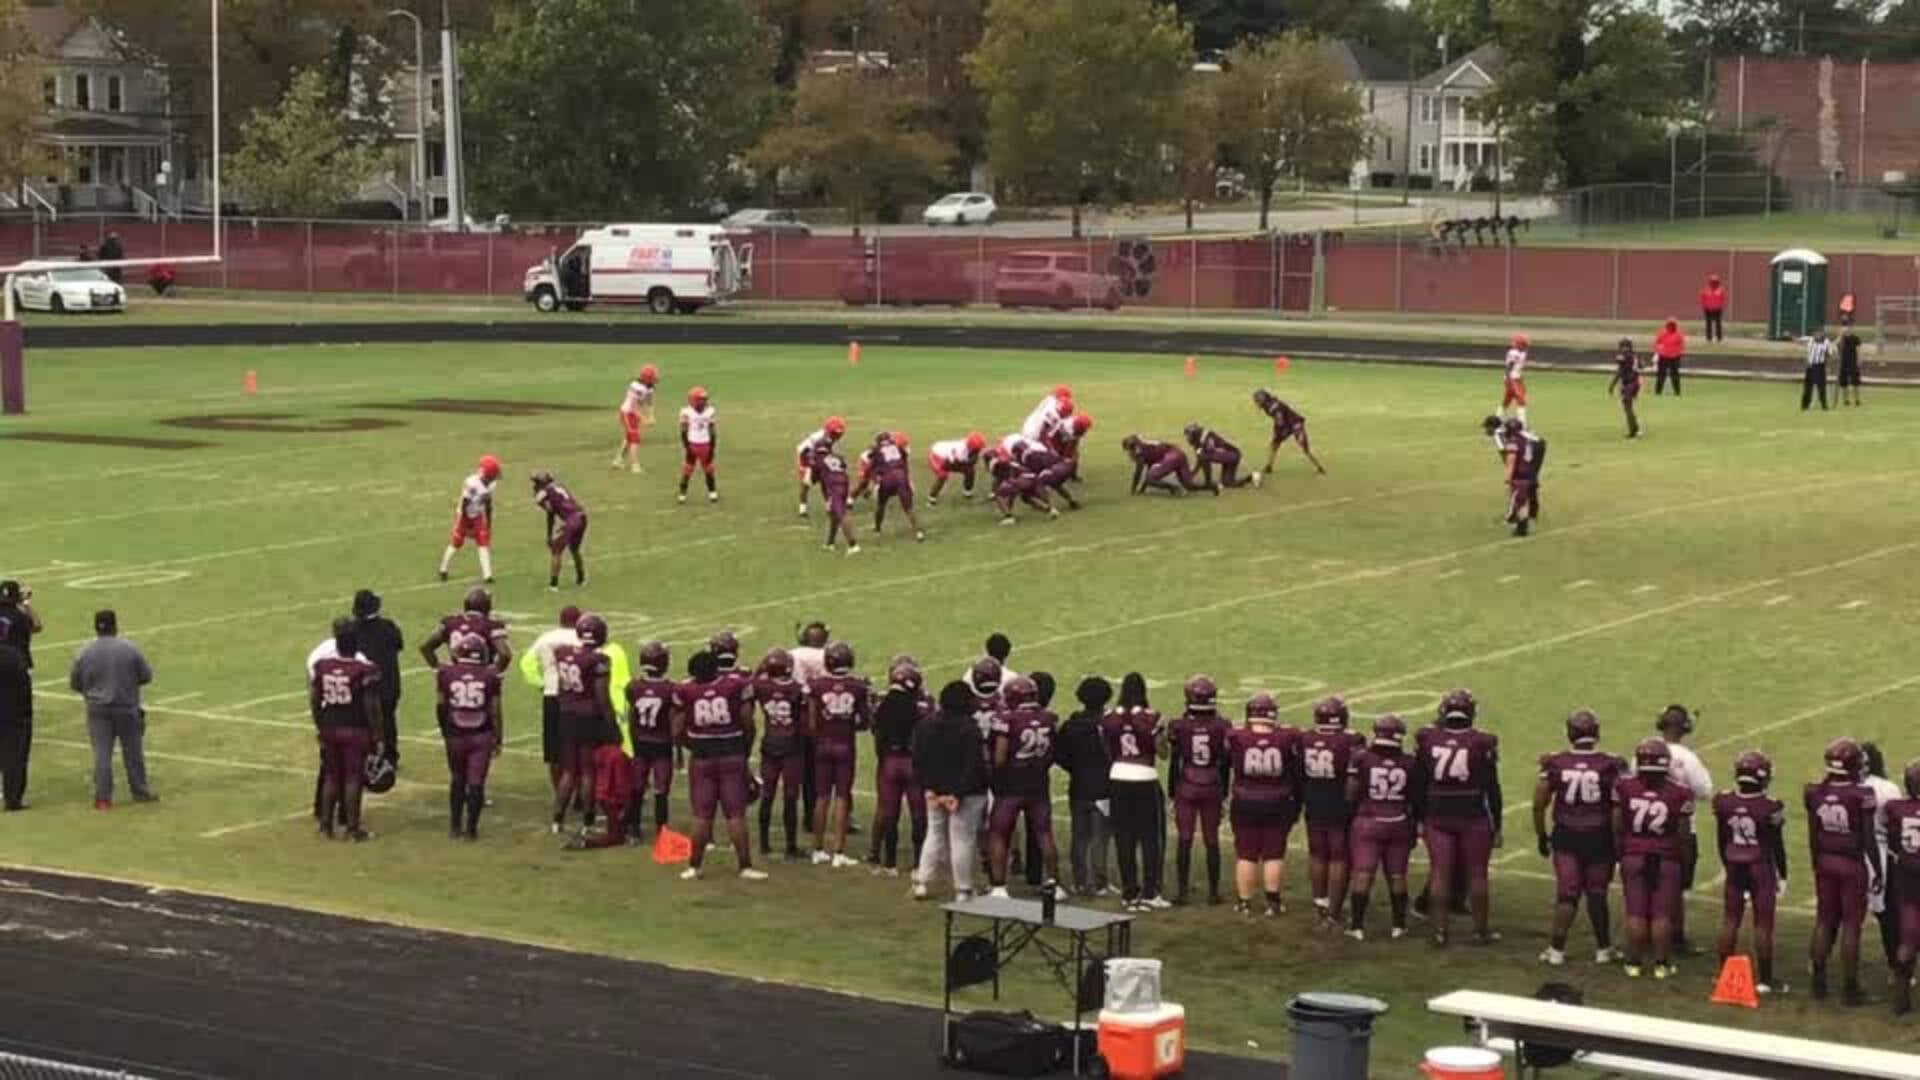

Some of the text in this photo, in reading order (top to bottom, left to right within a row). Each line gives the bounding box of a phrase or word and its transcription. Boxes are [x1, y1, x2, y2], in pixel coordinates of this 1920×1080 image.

[323, 674, 352, 704] 55
[450, 681, 484, 708] 35
[693, 696, 730, 726] 88
[1015, 727, 1050, 759] 25
[1192, 735, 1210, 766] 5
[1431, 746, 1468, 782] 74
[1369, 767, 1407, 800] 52
[1629, 798, 1668, 835] 72
